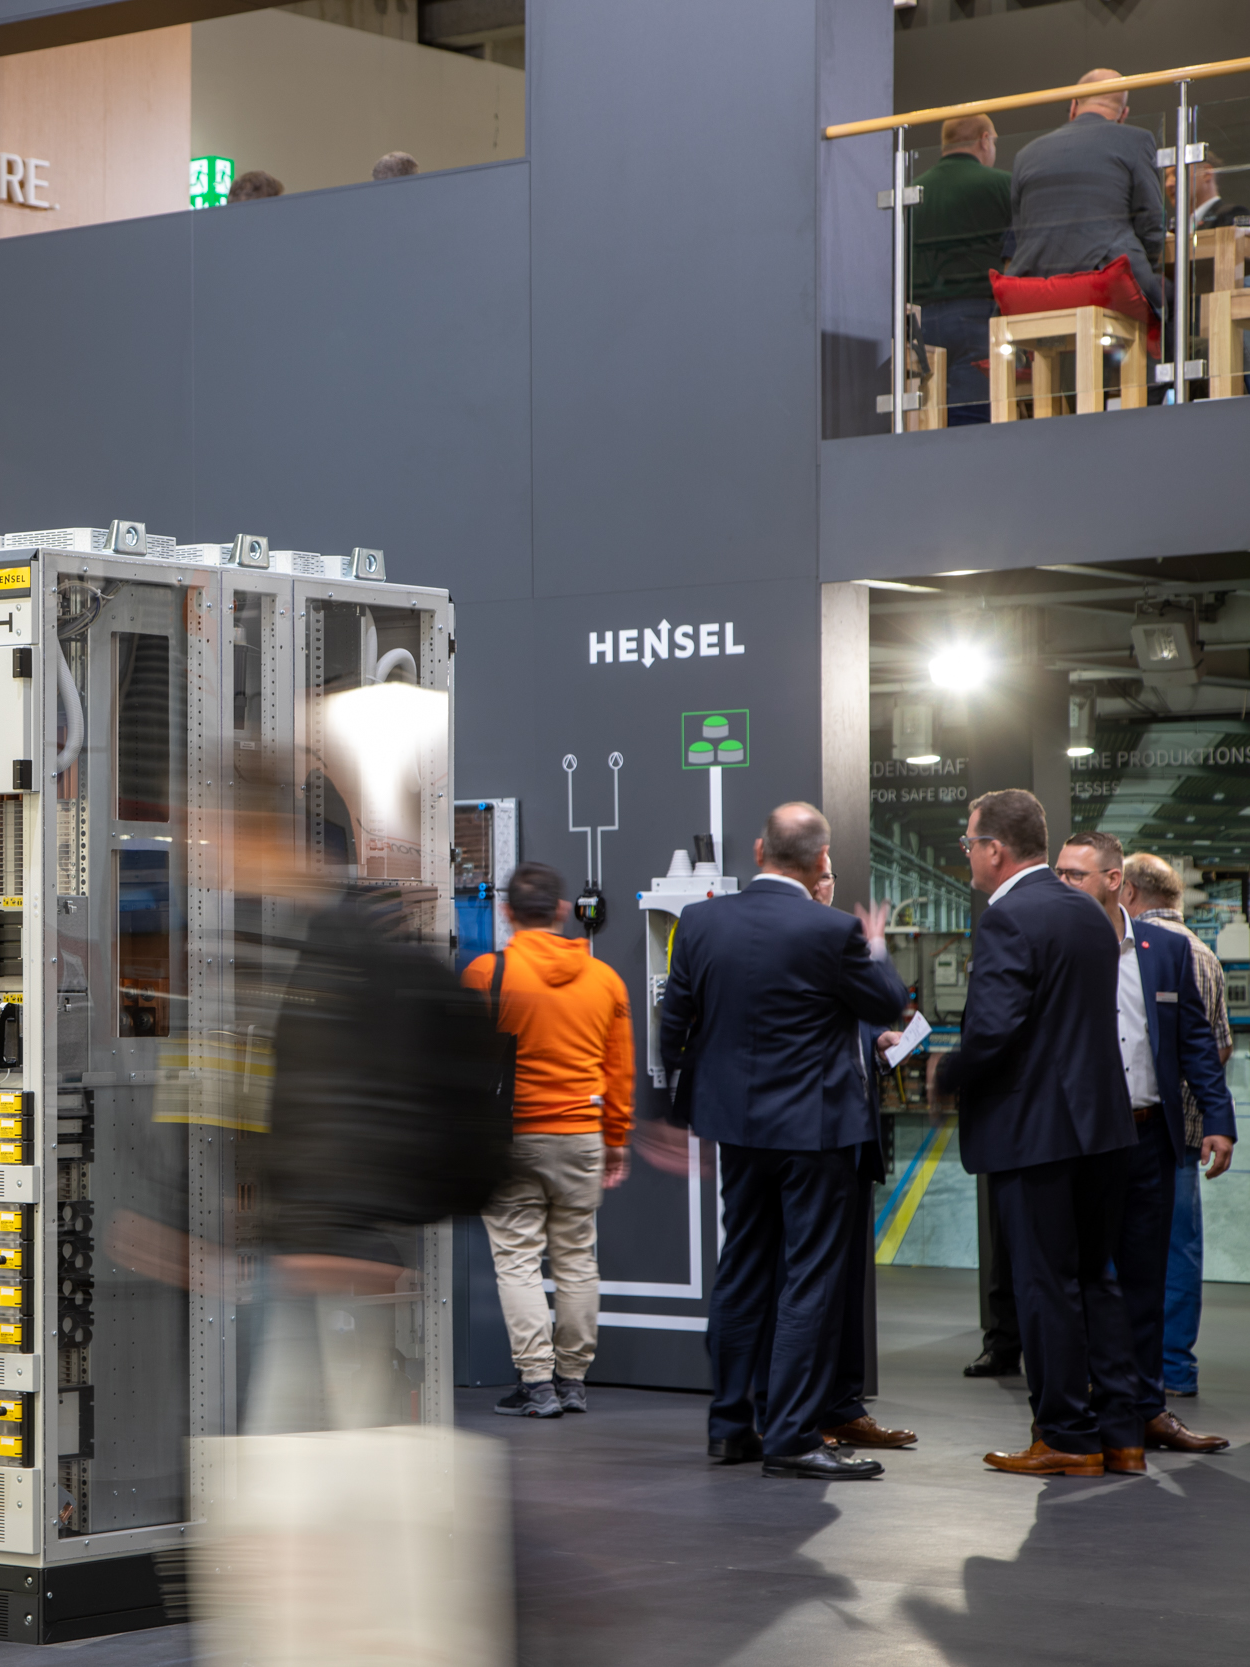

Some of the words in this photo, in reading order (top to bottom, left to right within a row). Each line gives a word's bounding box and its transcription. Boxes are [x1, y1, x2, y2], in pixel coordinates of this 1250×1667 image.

[589, 618, 745, 669] HENSEL
[870, 757, 970, 778] DENSCHAF
[870, 788, 897, 804] FOR
[901, 786, 935, 802] SAFE
